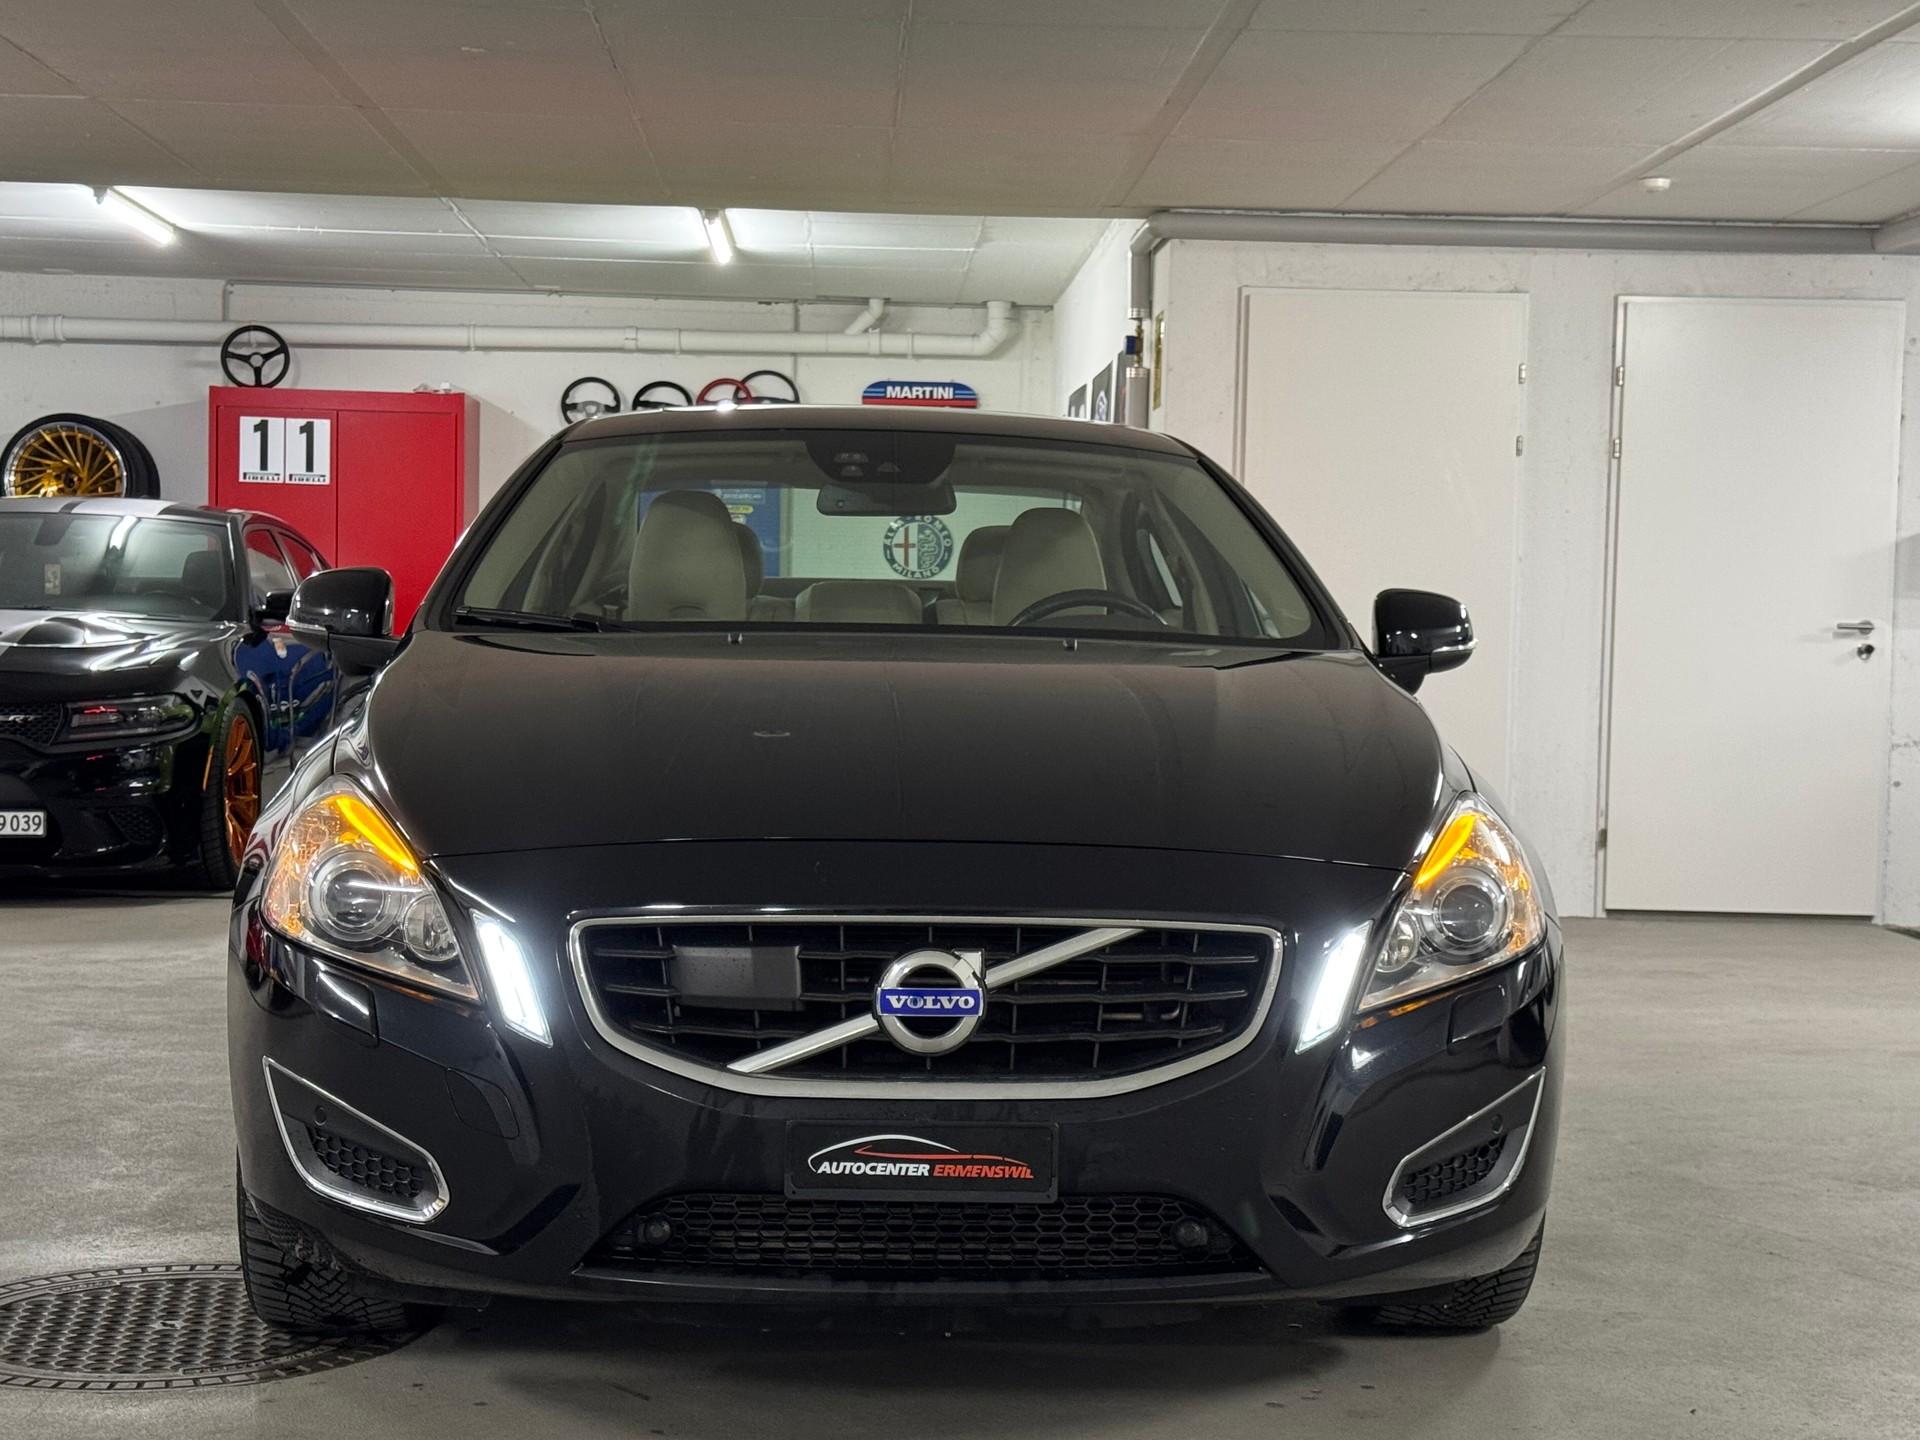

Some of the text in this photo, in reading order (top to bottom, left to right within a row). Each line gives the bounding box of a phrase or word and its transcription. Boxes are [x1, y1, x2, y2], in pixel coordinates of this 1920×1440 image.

[886, 386, 954, 399] MARTINI
[254, 419, 269, 471] 1
[299, 421, 315, 473] 1
[893, 563, 940, 578] MILANO
[885, 995, 975, 1009] VOLVO
[817, 1161, 1034, 1179] AUTOCENTER ERMENSWIL
